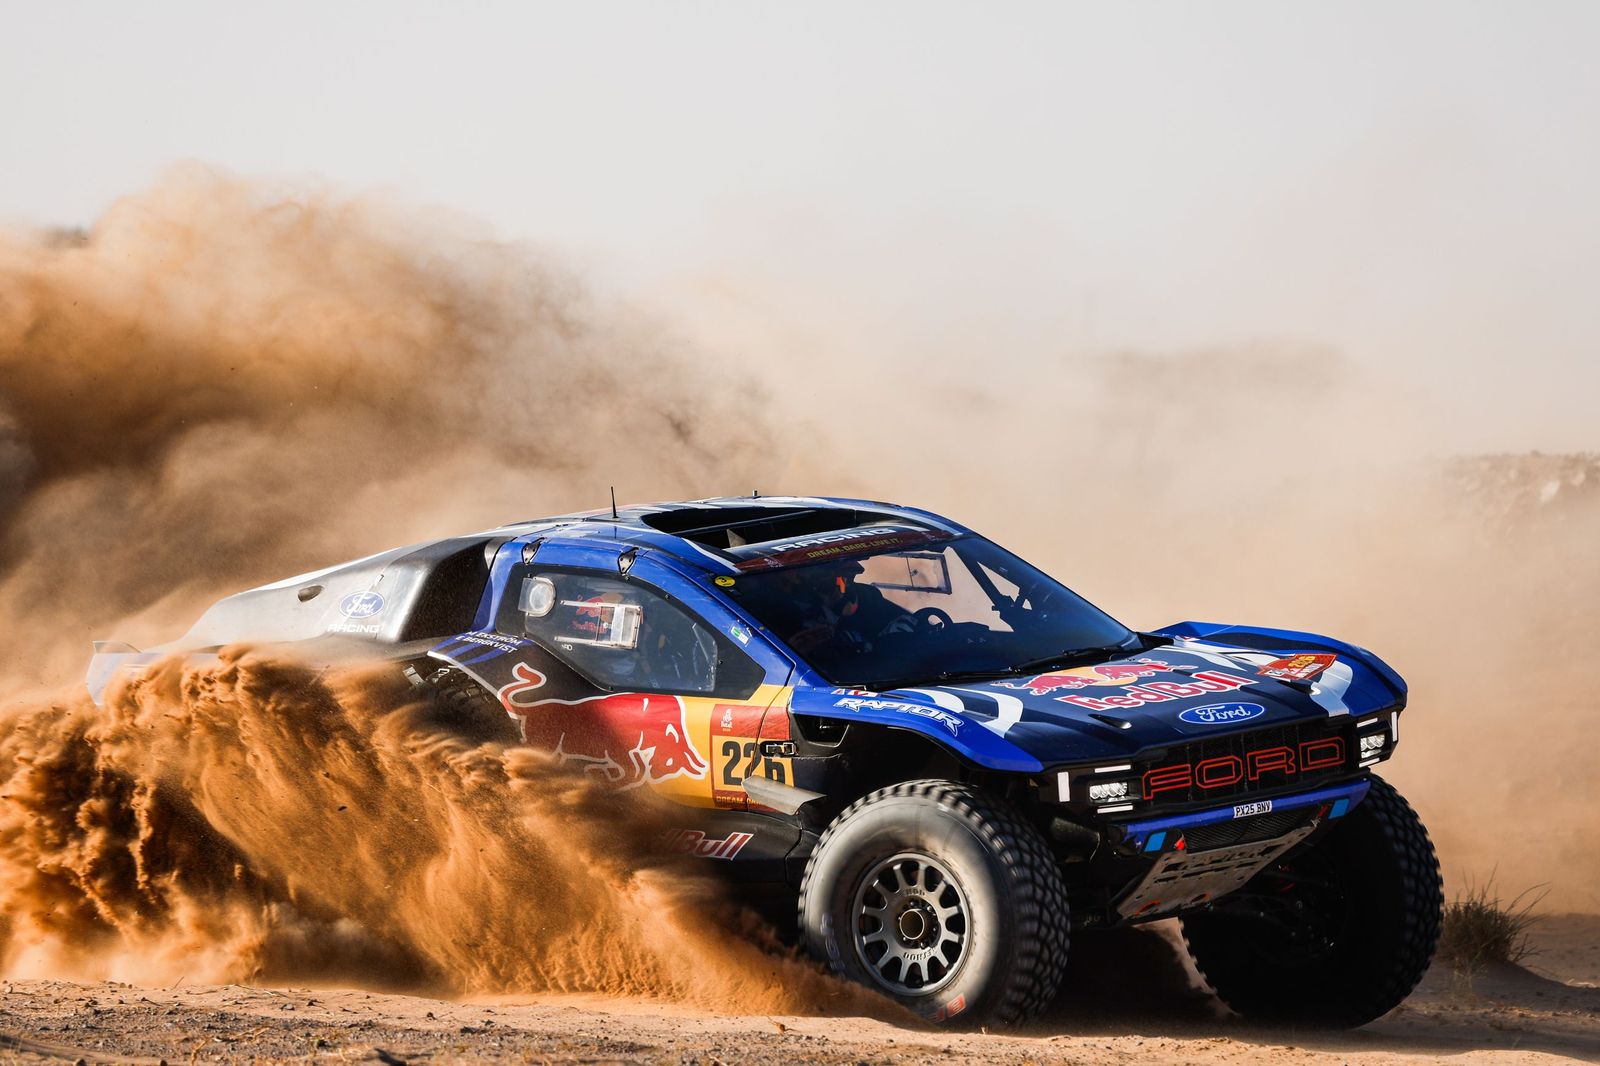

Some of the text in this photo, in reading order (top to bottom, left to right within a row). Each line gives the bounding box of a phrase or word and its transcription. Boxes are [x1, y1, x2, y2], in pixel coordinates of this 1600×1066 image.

[771, 528, 896, 551] RACING
[347, 595, 377, 613] Ford
[327, 624, 380, 633] RACING
[833, 698, 964, 737] RAPTOR
[1195, 705, 1251, 722] Ford
[1142, 737, 1345, 800] FORD
[1236, 801, 1271, 816] PX25 BNV
